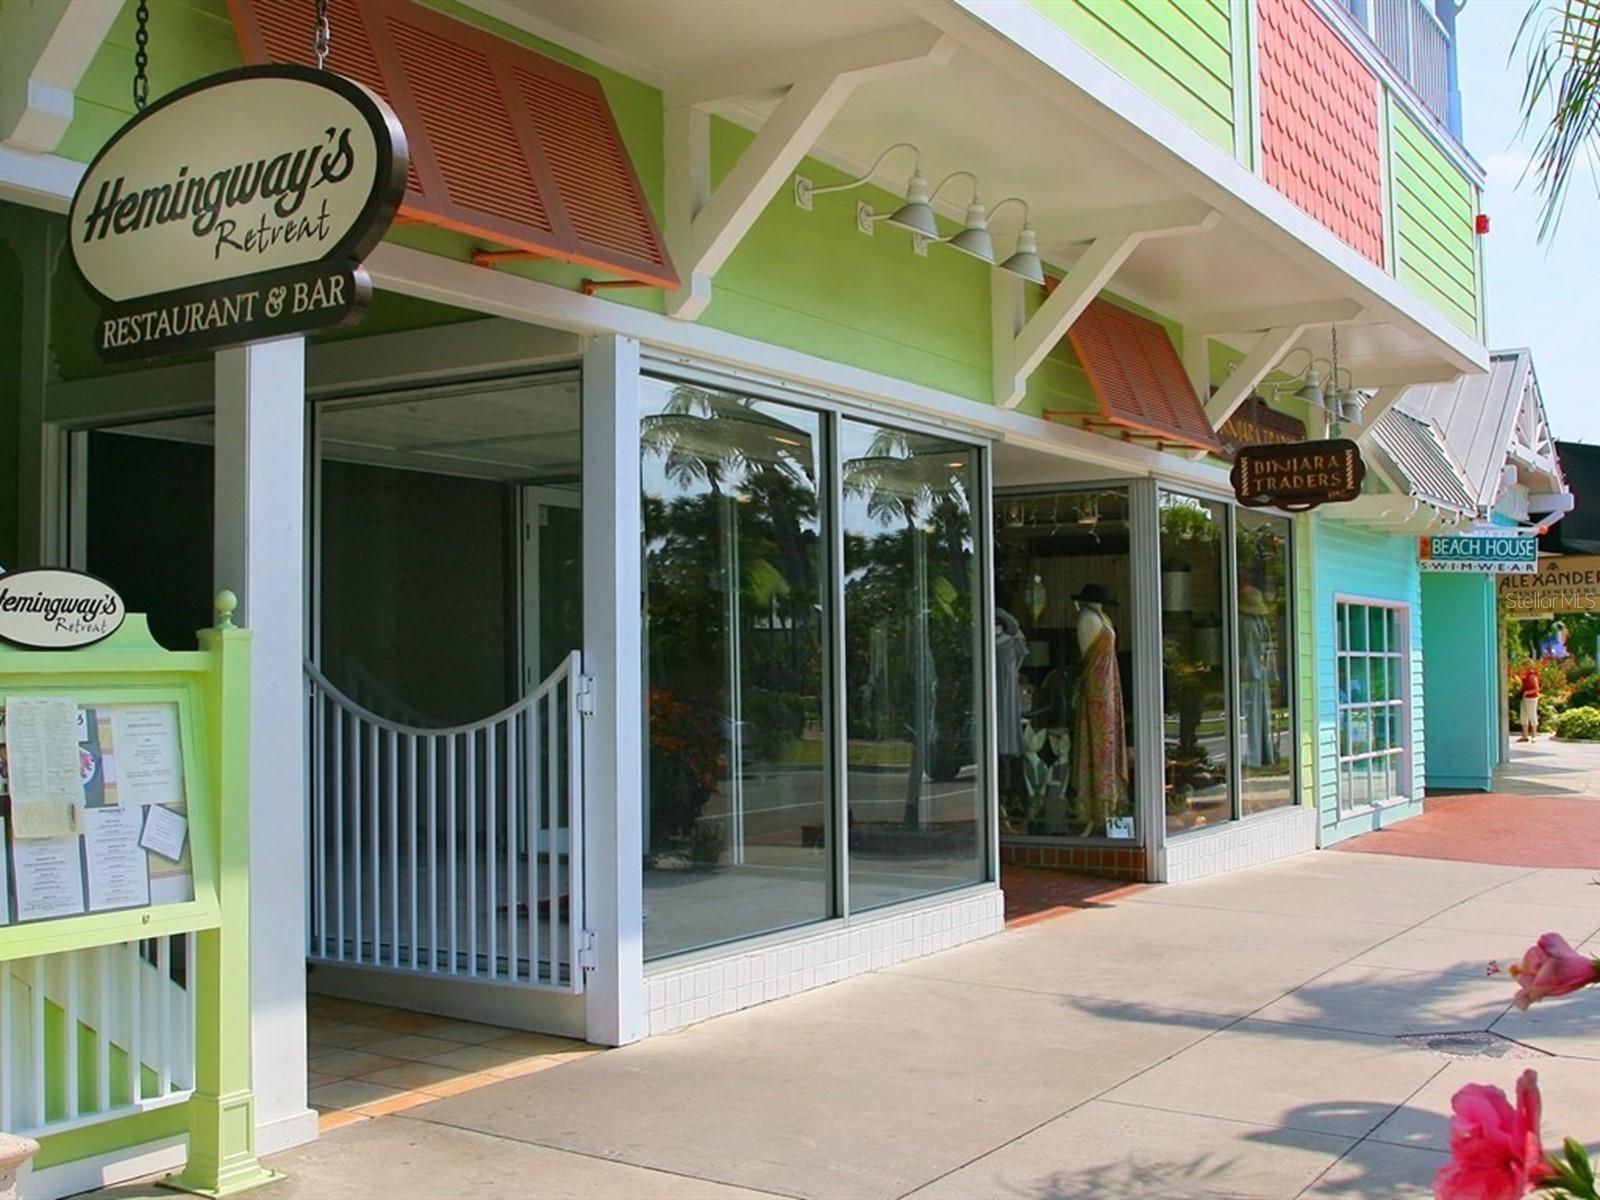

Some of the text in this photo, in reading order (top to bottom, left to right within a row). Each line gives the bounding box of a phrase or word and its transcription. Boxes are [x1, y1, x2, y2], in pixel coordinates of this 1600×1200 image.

[83, 126, 354, 244] Hemingway's
[213, 198, 331, 260] Retreat
[102, 274, 345, 349] RESTAURANT & BAR
[1253, 472, 1341, 491] TRADERS
[1431, 538, 1534, 556] BEACH HOUSE
[54, 617, 107, 634] Retreat
